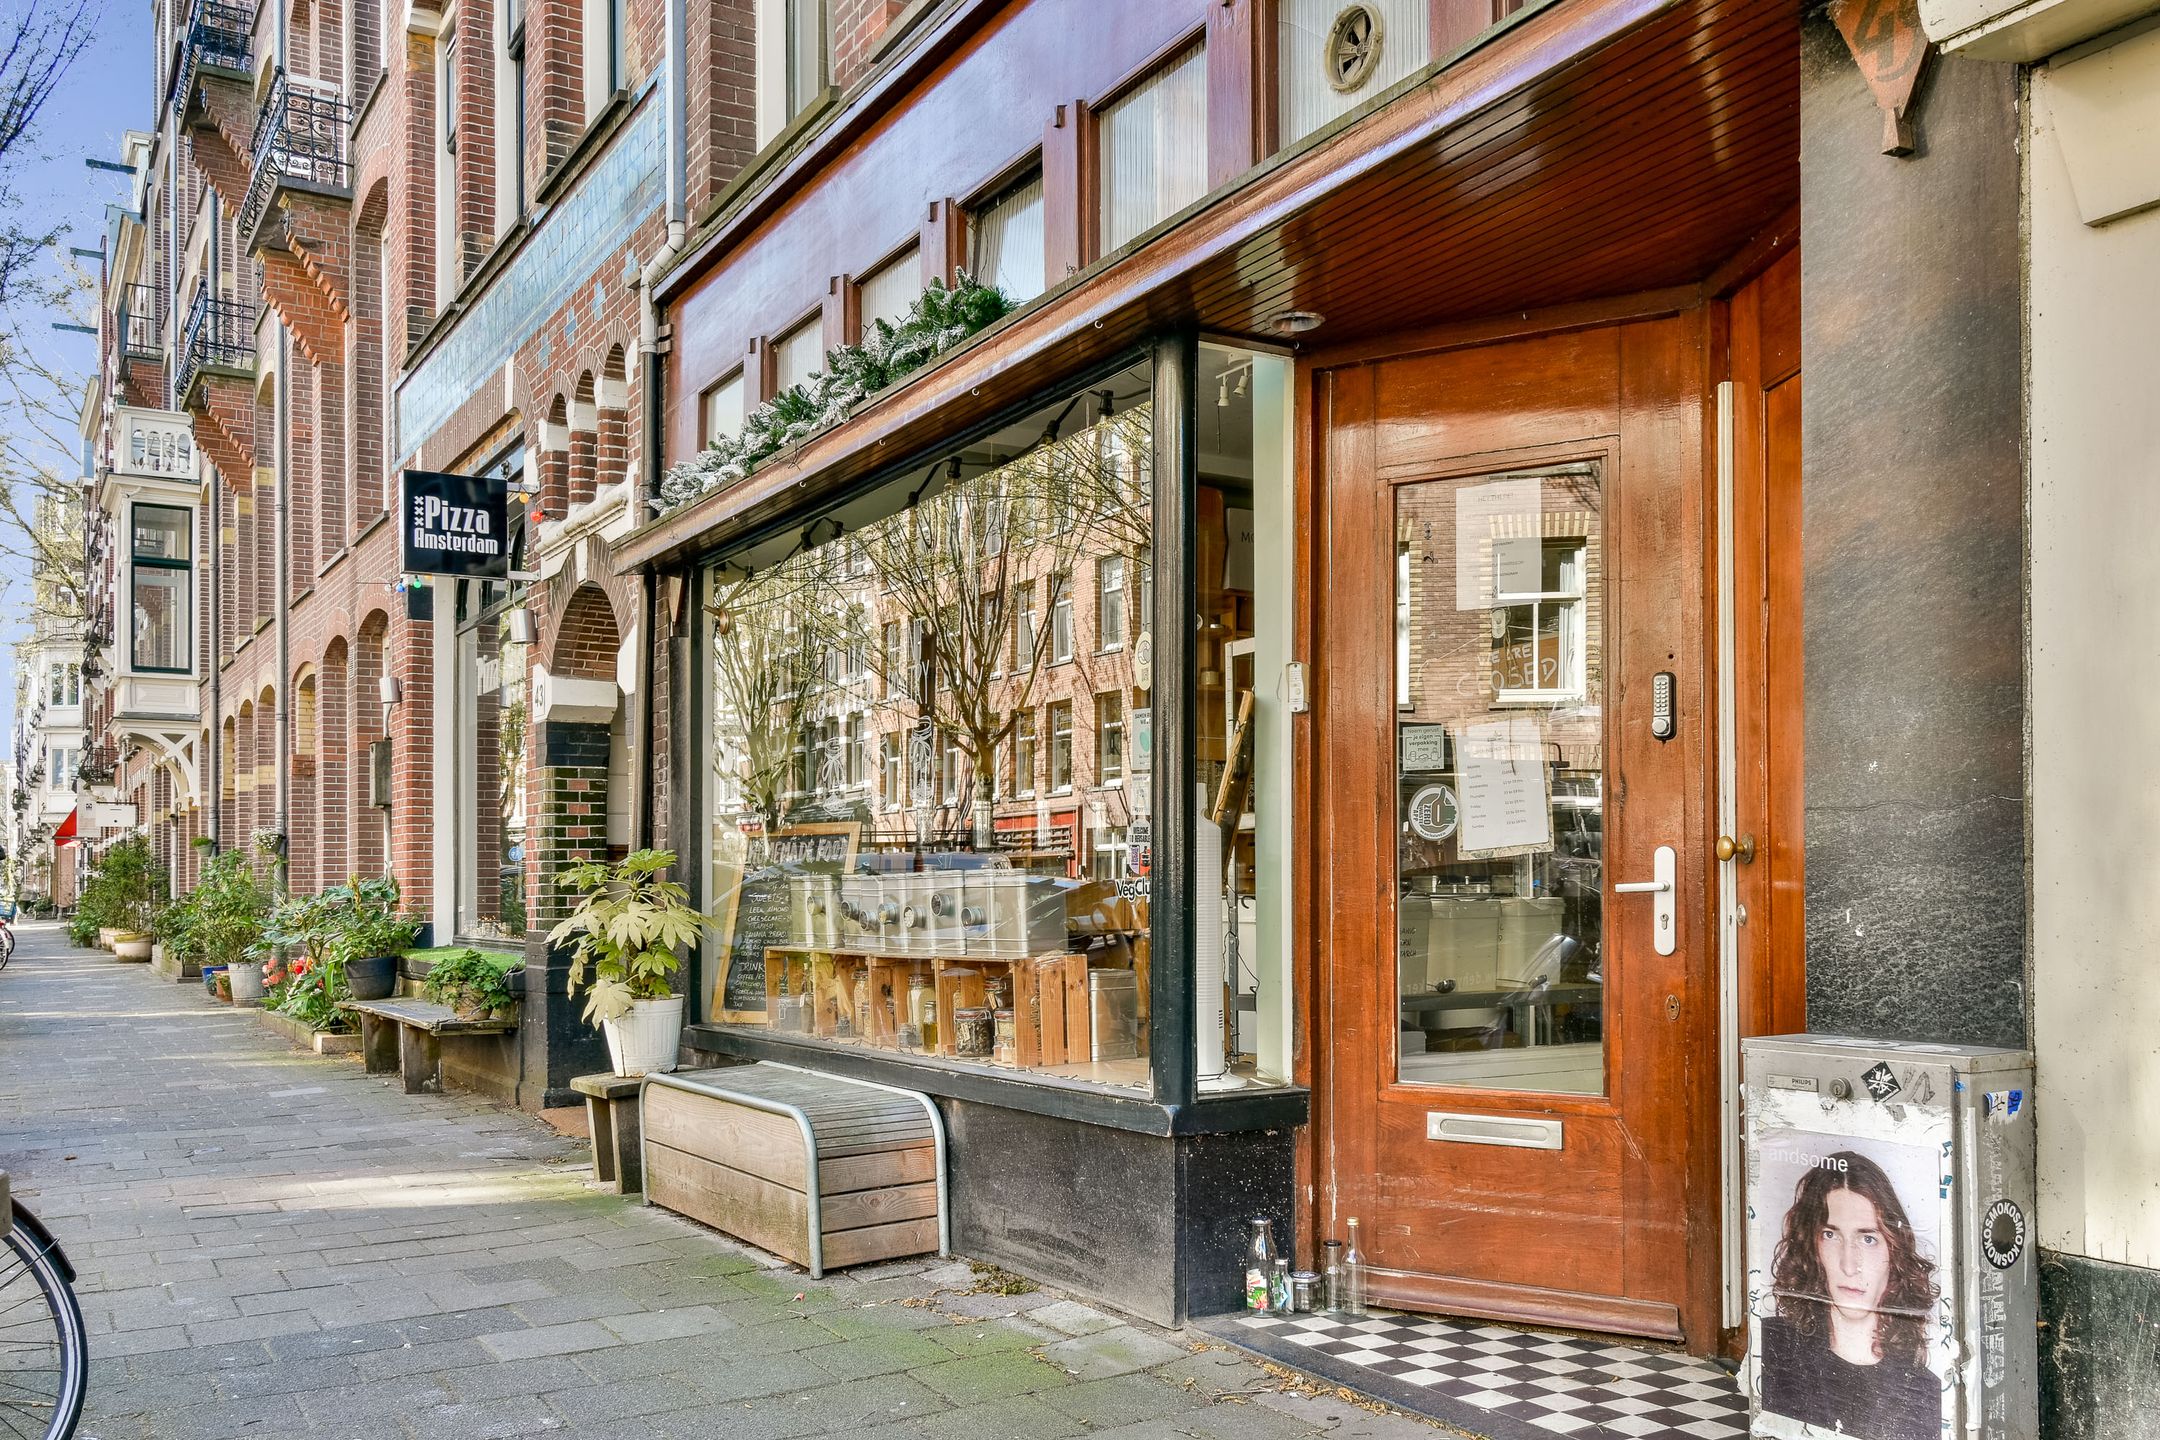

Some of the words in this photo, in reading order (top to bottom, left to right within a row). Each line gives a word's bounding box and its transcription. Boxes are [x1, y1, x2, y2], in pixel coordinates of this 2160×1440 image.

[425, 495, 490, 534] Pizza
[414, 527, 499, 555] Amsterdam
[1457, 657, 1558, 696] CLOSED
[535, 684, 544, 707] 43
[1116, 878, 1151, 901] VegClu
